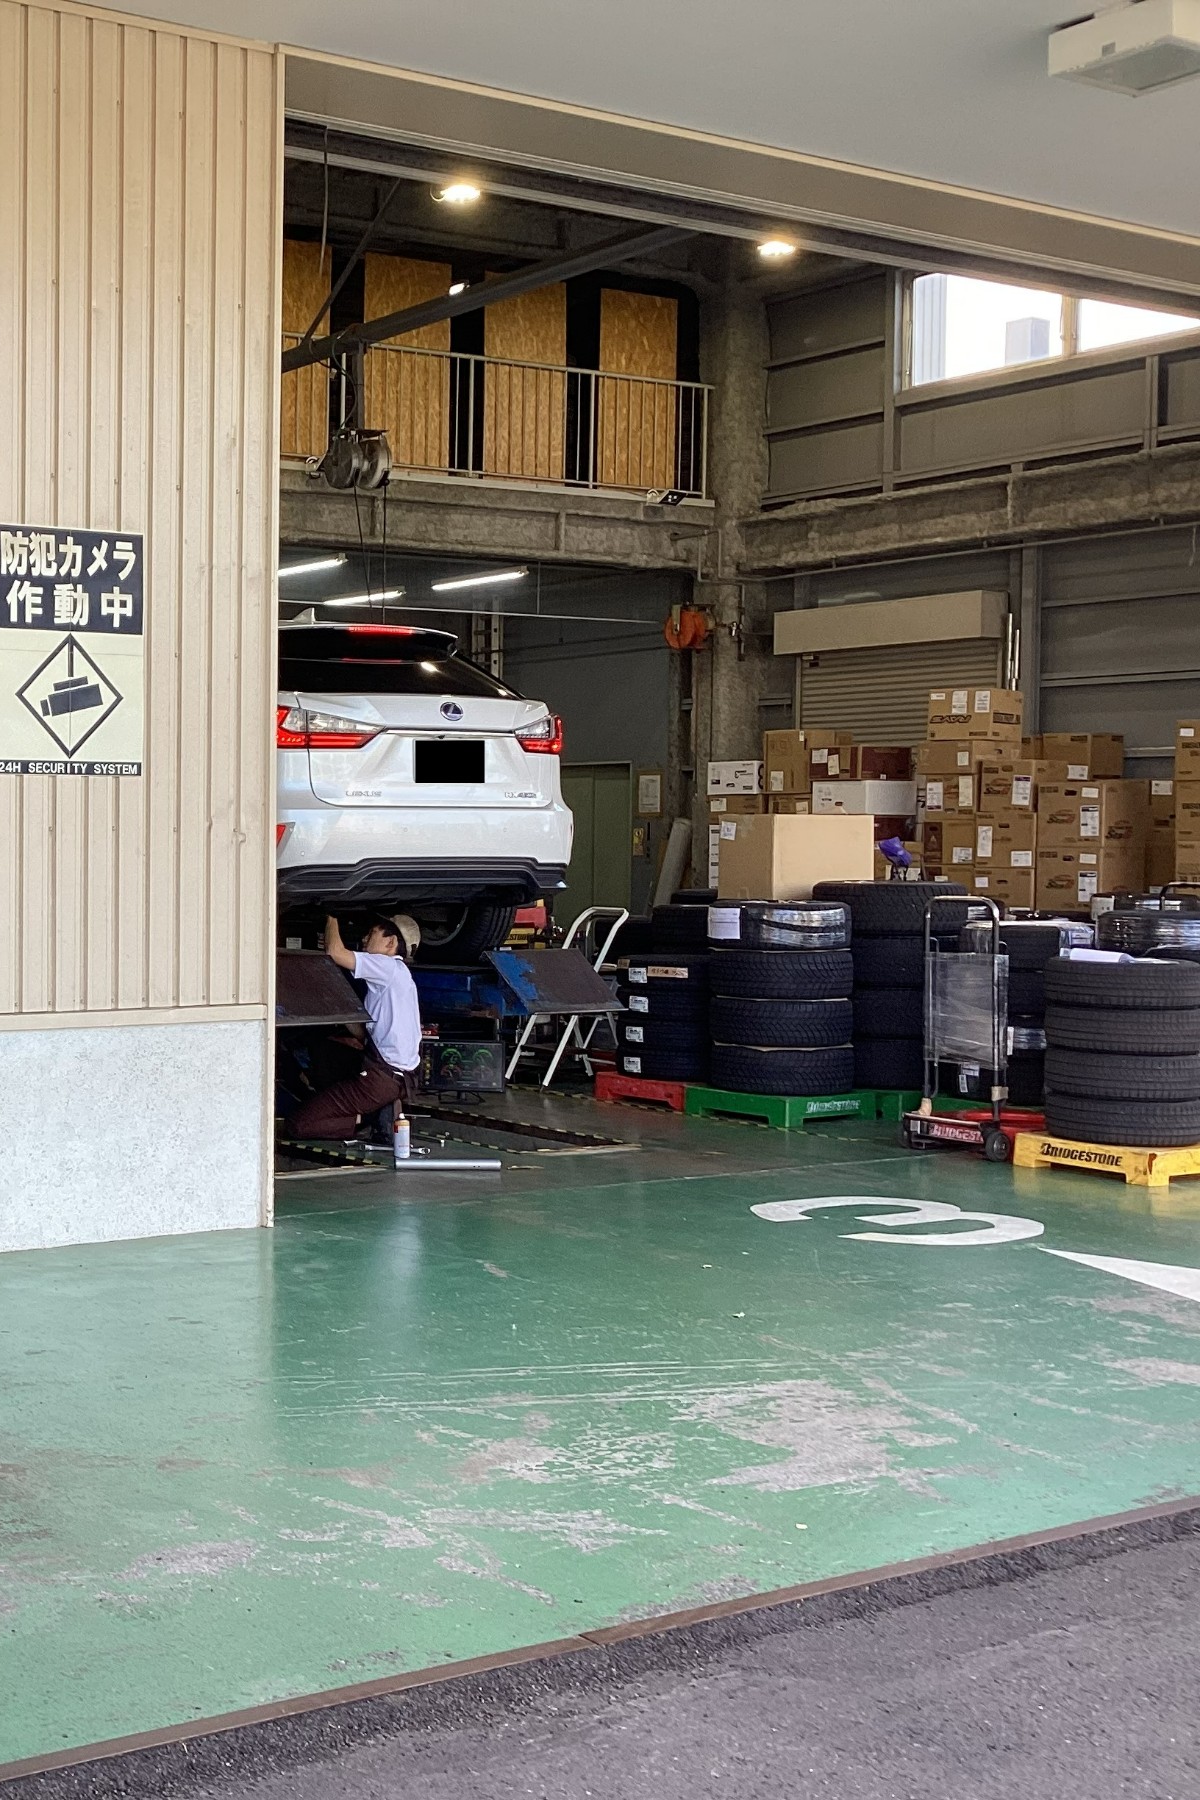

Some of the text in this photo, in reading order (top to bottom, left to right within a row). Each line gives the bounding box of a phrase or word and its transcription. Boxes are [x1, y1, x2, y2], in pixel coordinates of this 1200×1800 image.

[0, 530, 136, 580] 防犯カメラ
[6, 580, 133, 628] 作動中
[28, 762, 88, 774] SECURITY
[93, 764, 138, 775] SYSTEM
[932, 1123, 982, 1141] BRIDGEST
[1040, 1142, 1123, 1166] BRIDGESTONE
[749, 1196, 1045, 1246] 3
